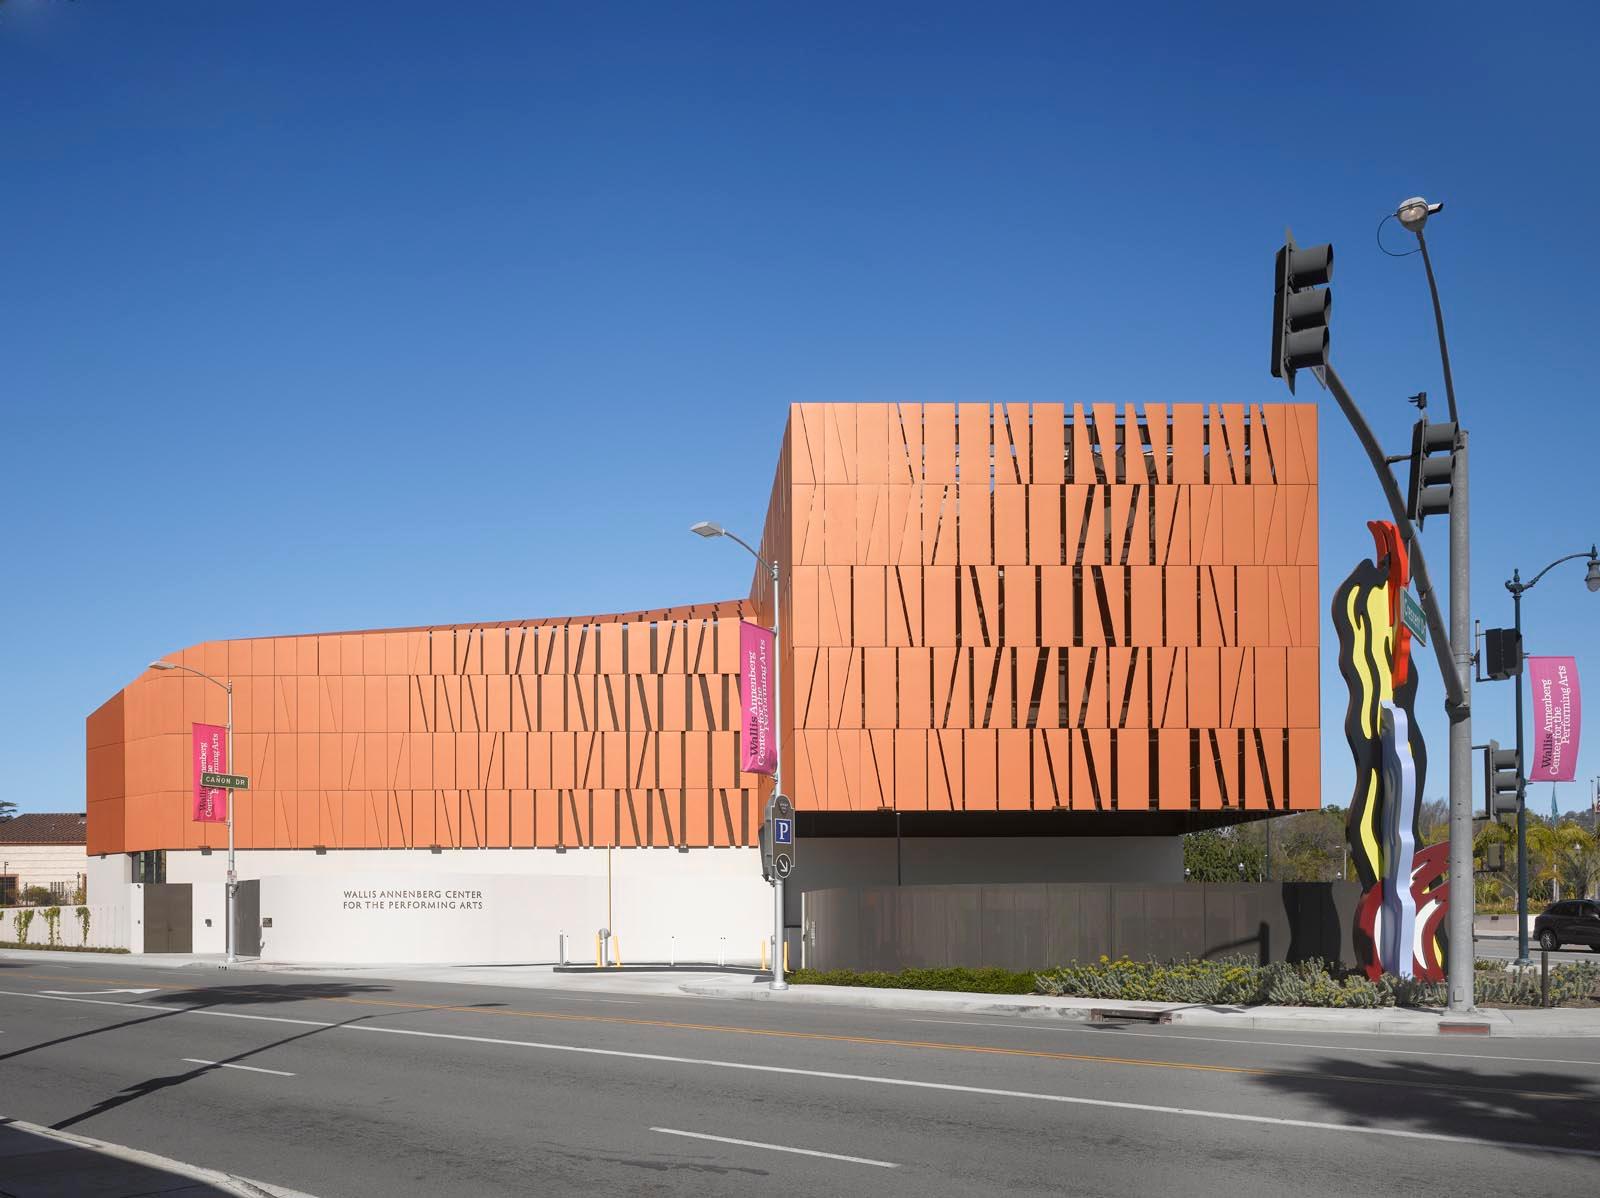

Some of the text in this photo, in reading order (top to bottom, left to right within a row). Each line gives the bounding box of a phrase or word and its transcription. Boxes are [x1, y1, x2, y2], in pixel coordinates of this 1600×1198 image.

[759, 639, 767, 665] Arts
[748, 650, 758, 757] Wallis Annenberg
[1558, 665, 1571, 744] Performing Arts
[1541, 679, 1553, 768] Wallis Annenberg
[757, 725, 766, 766] Center
[1549, 706, 1562, 775] Center for the
[205, 775, 231, 785] CAÑON
[779, 822, 788, 840] P
[343, 890, 482, 899] WALLIS ANNENBERG CENTER
[343, 901, 483, 910] FOR THE PERFORMING ARTS
